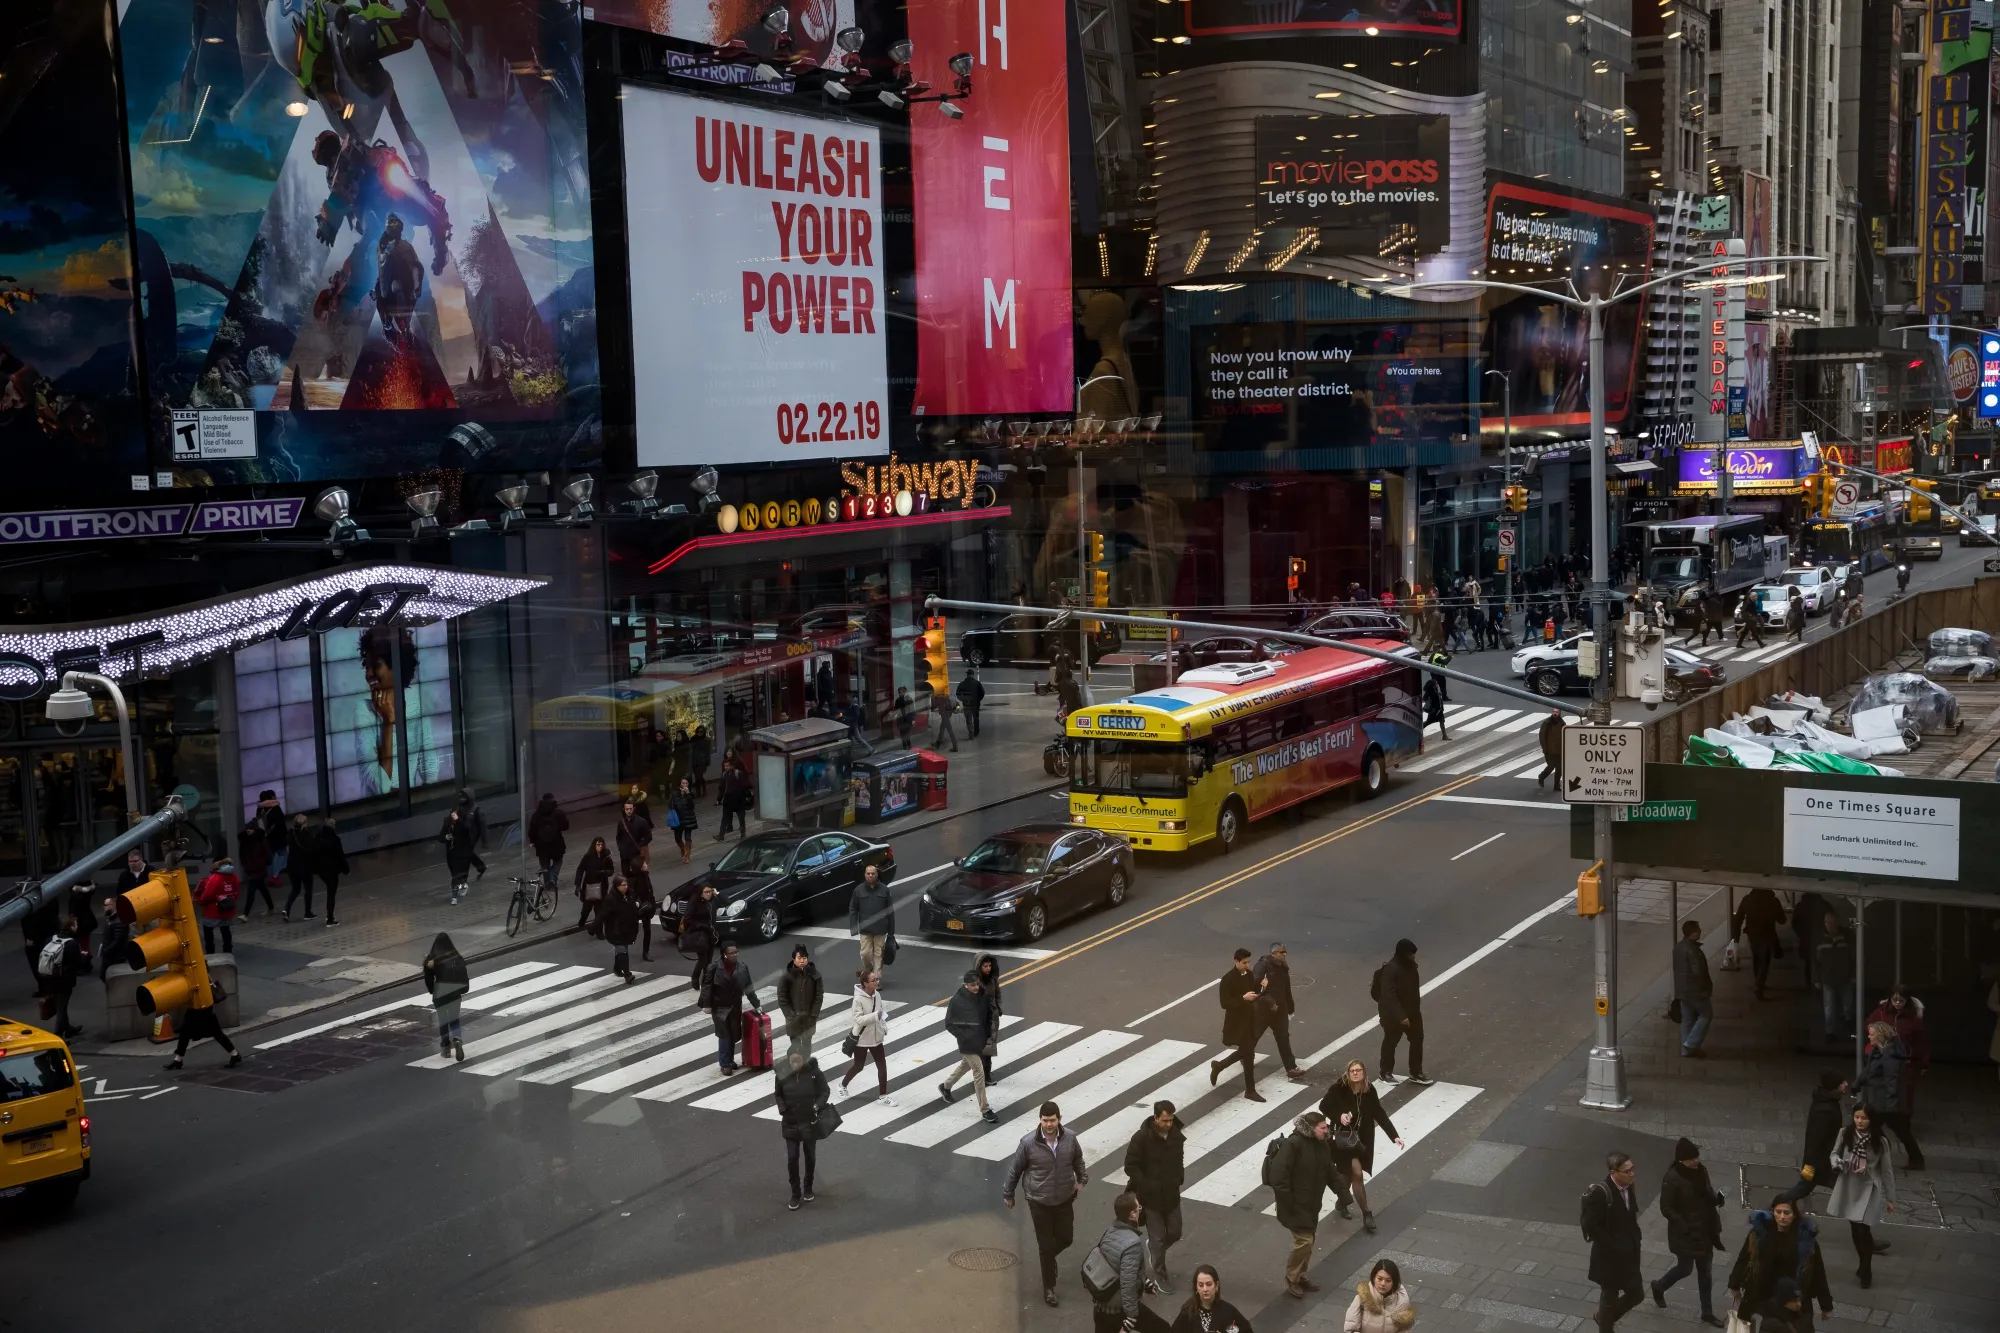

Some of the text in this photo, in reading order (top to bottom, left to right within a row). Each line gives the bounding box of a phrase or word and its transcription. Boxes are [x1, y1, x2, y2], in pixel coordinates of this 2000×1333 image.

[671, 55, 746, 83] OUTFRONT
[695, 116, 870, 199] UNLEASH
[1268, 155, 1439, 190] moviepass
[1268, 188, 1440, 208] Let's go to the movies.
[1933, 75, 1960, 313] TUSSAUDS
[771, 201, 874, 267] YOUR
[1495, 211, 1598, 245] The best place to see a movie
[1491, 238, 1554, 265] is at the movies.
[742, 271, 876, 334] POWER
[1747, 283, 1767, 300] ALDO
[1710, 241, 1728, 415] AMSTERDAM
[1210, 347, 1352, 367] Now you know why
[1948, 356, 1976, 379] DAVE &
[1210, 366, 1288, 384] they call it
[1392, 367, 1408, 376] You
[1423, 367, 1443, 375] here.
[1211, 382, 1353, 400] the theater district.
[777, 401, 880, 445] 02.22.19
[1652, 422, 1696, 448] SEPHORA
[176, 423, 196, 451] T
[840, 451, 979, 508] Subway
[0, 503, 292, 540] OUTFRONT PRIME
[747, 508, 756, 525] N
[767, 507, 778, 523] Q
[789, 505, 798, 522] R
[807, 503, 820, 518] W
[829, 501, 837, 518] S
[866, 498, 875, 515] 2
[884, 495, 892, 514] 3
[920, 494, 927, 510] 7
[276, 583, 429, 641] LOFT
[1101, 716, 1141, 729] FERRY
[1579, 733, 1627, 746] BUSES
[1231, 722, 1355, 785] The World's Best Ferry!
[1584, 750, 1621, 762] ONLY
[1613, 767, 1634, 775] 10AM
[1615, 778, 1632, 786] 7PM
[1585, 788, 1604, 796] MON
[1624, 789, 1638, 797] FRI
[1073, 802, 1177, 817] The Civilized Commute!
[1632, 803, 1692, 821] Broadway
[1806, 797, 1936, 817] One Times Square
[1821, 834, 1918, 848] Landmark Unlimited Inc.
